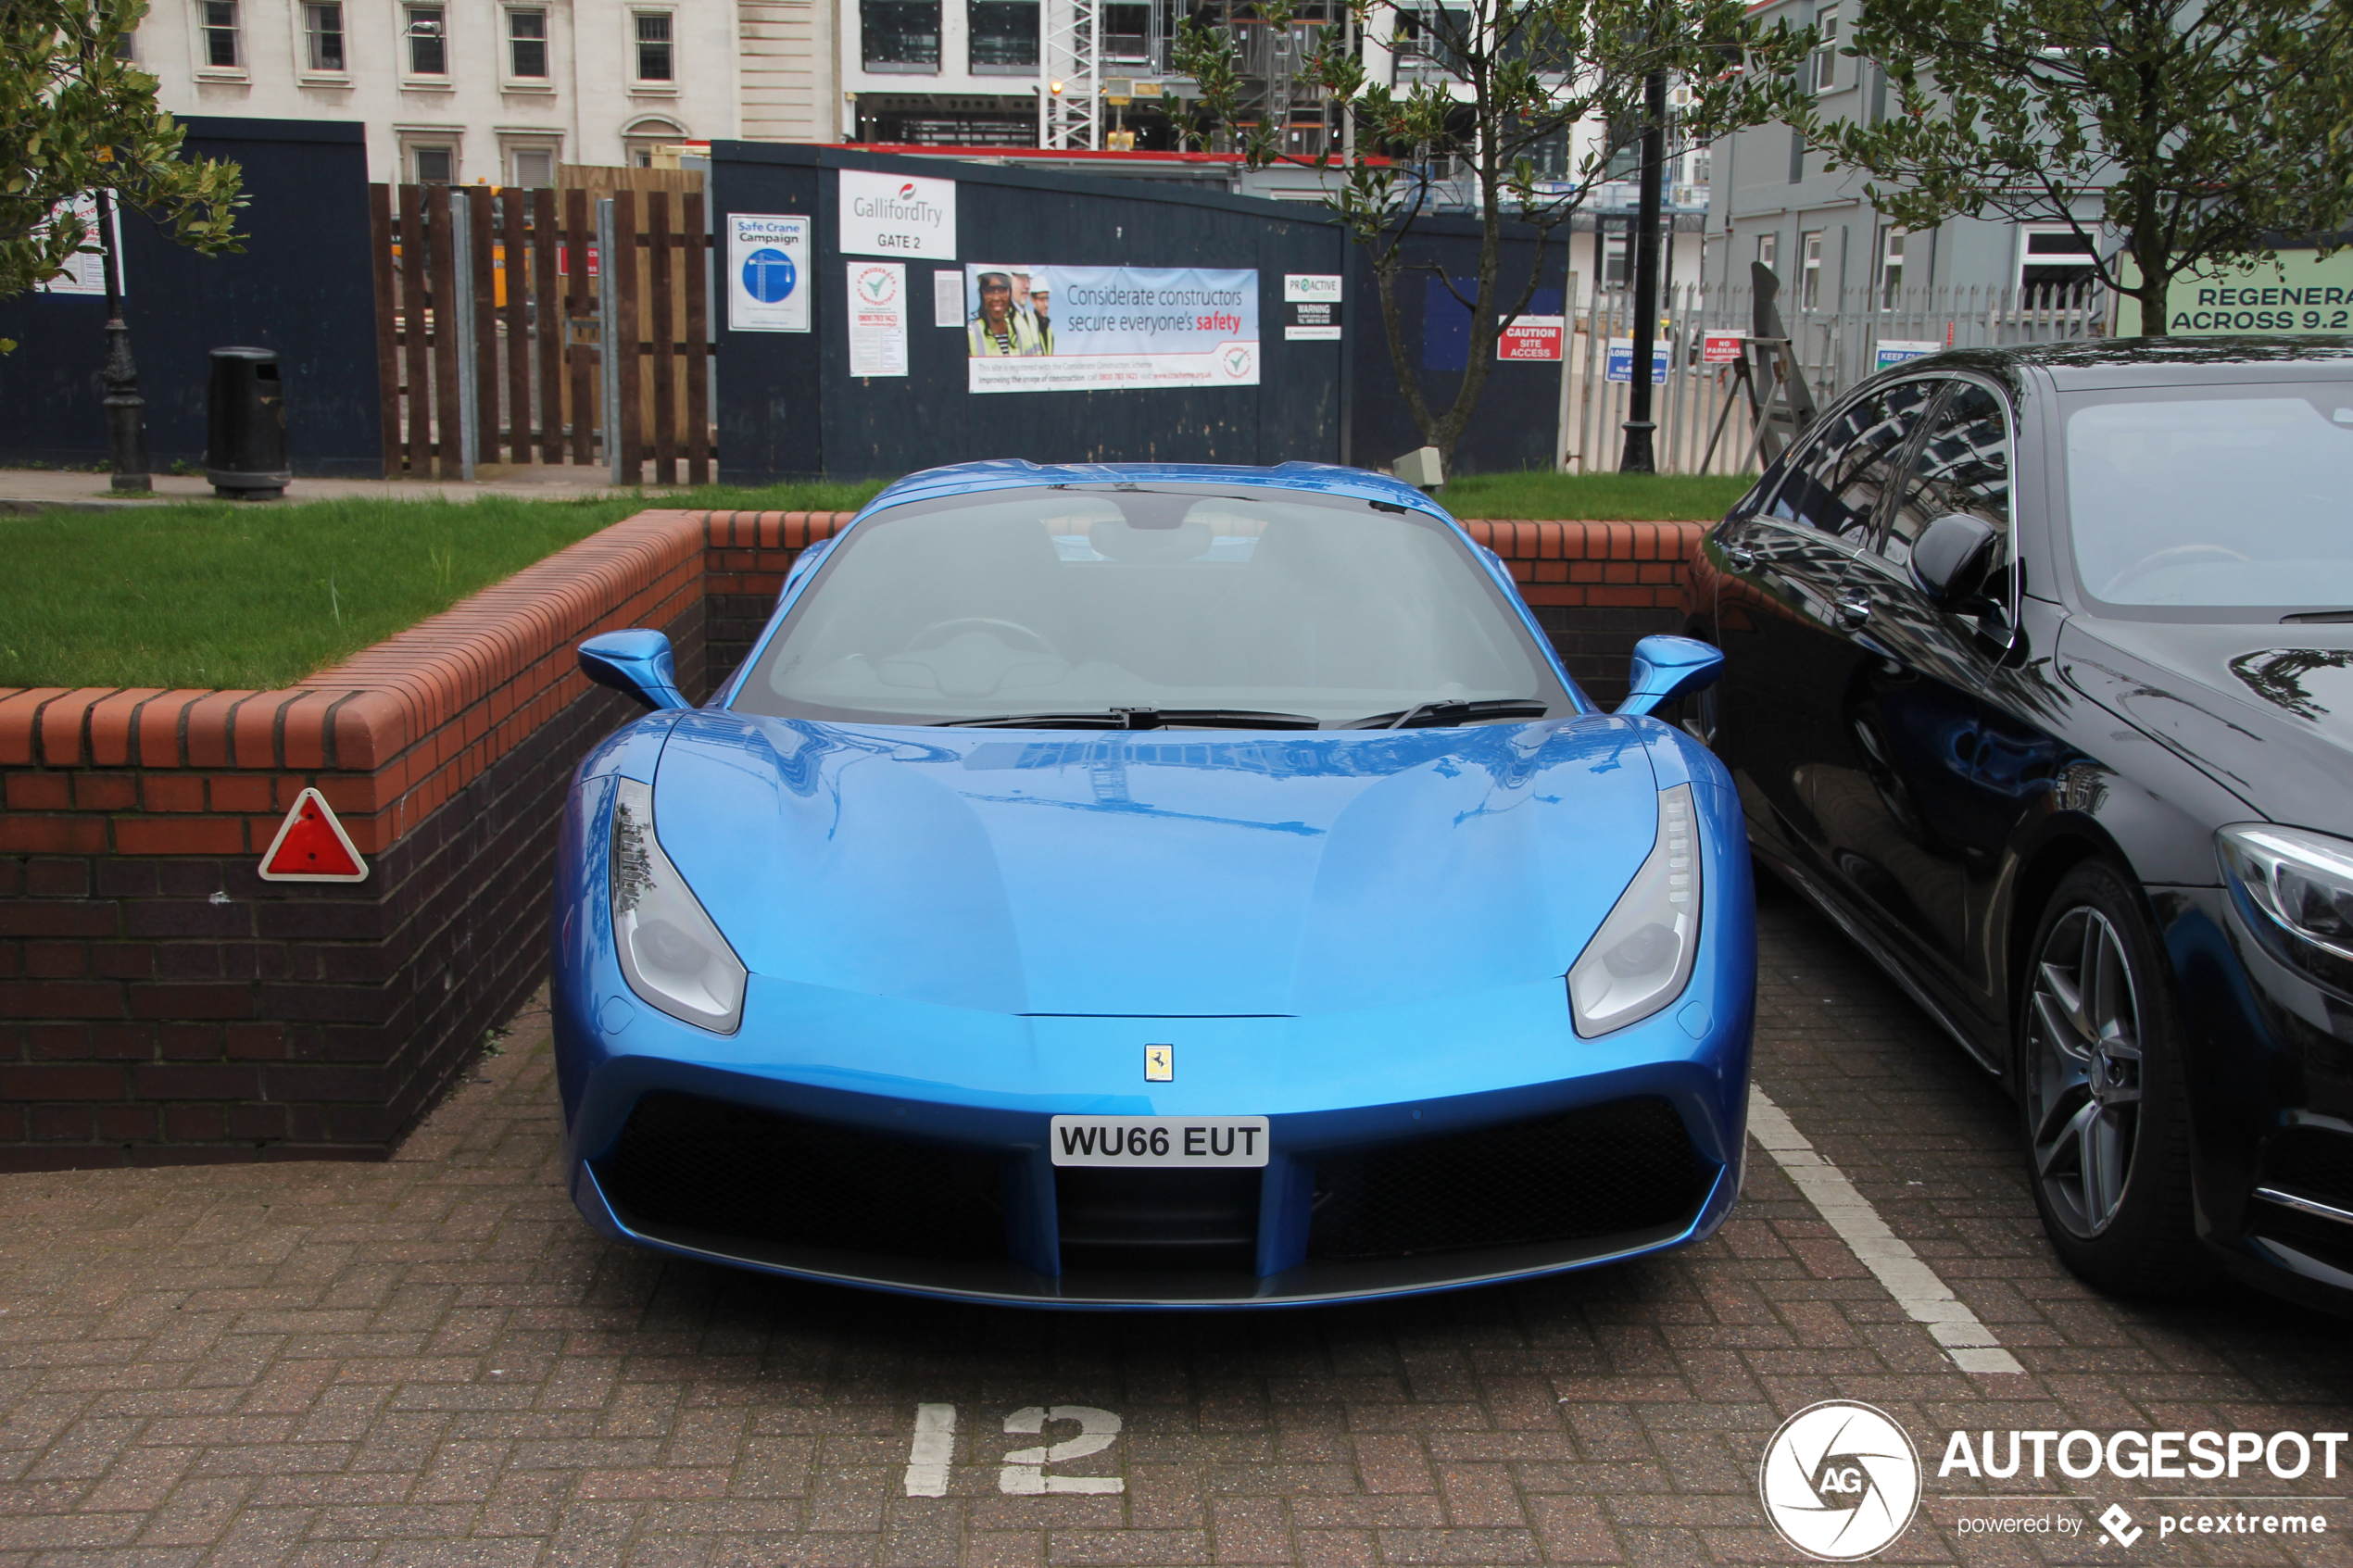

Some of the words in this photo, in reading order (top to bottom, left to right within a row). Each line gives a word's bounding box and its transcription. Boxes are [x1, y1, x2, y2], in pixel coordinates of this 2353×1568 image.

[854, 197, 942, 228] GallifordTry
[738, 222, 763, 232] Safe
[766, 223, 799, 233] Crane
[739, 232, 799, 245] Campaign
[877, 233, 911, 248] GATE
[913, 237, 921, 249] 2
[1067, 284, 1154, 306] Considerate
[1158, 289, 1242, 306] constructors
[1297, 304, 1330, 314] WARNING
[1068, 316, 1117, 332] secure
[1196, 310, 1241, 335] safety
[2171, 311, 2294, 330] ACROSS
[2302, 310, 2348, 330] 9.2
[1506, 327, 1556, 338] CAUTION
[1519, 339, 1541, 348] SITE
[1510, 348, 1551, 358] ACCESS
[1881, 352, 1904, 360] KEEP
[1060, 1126, 1170, 1156] WU66
[1184, 1126, 1262, 1156] EUT
